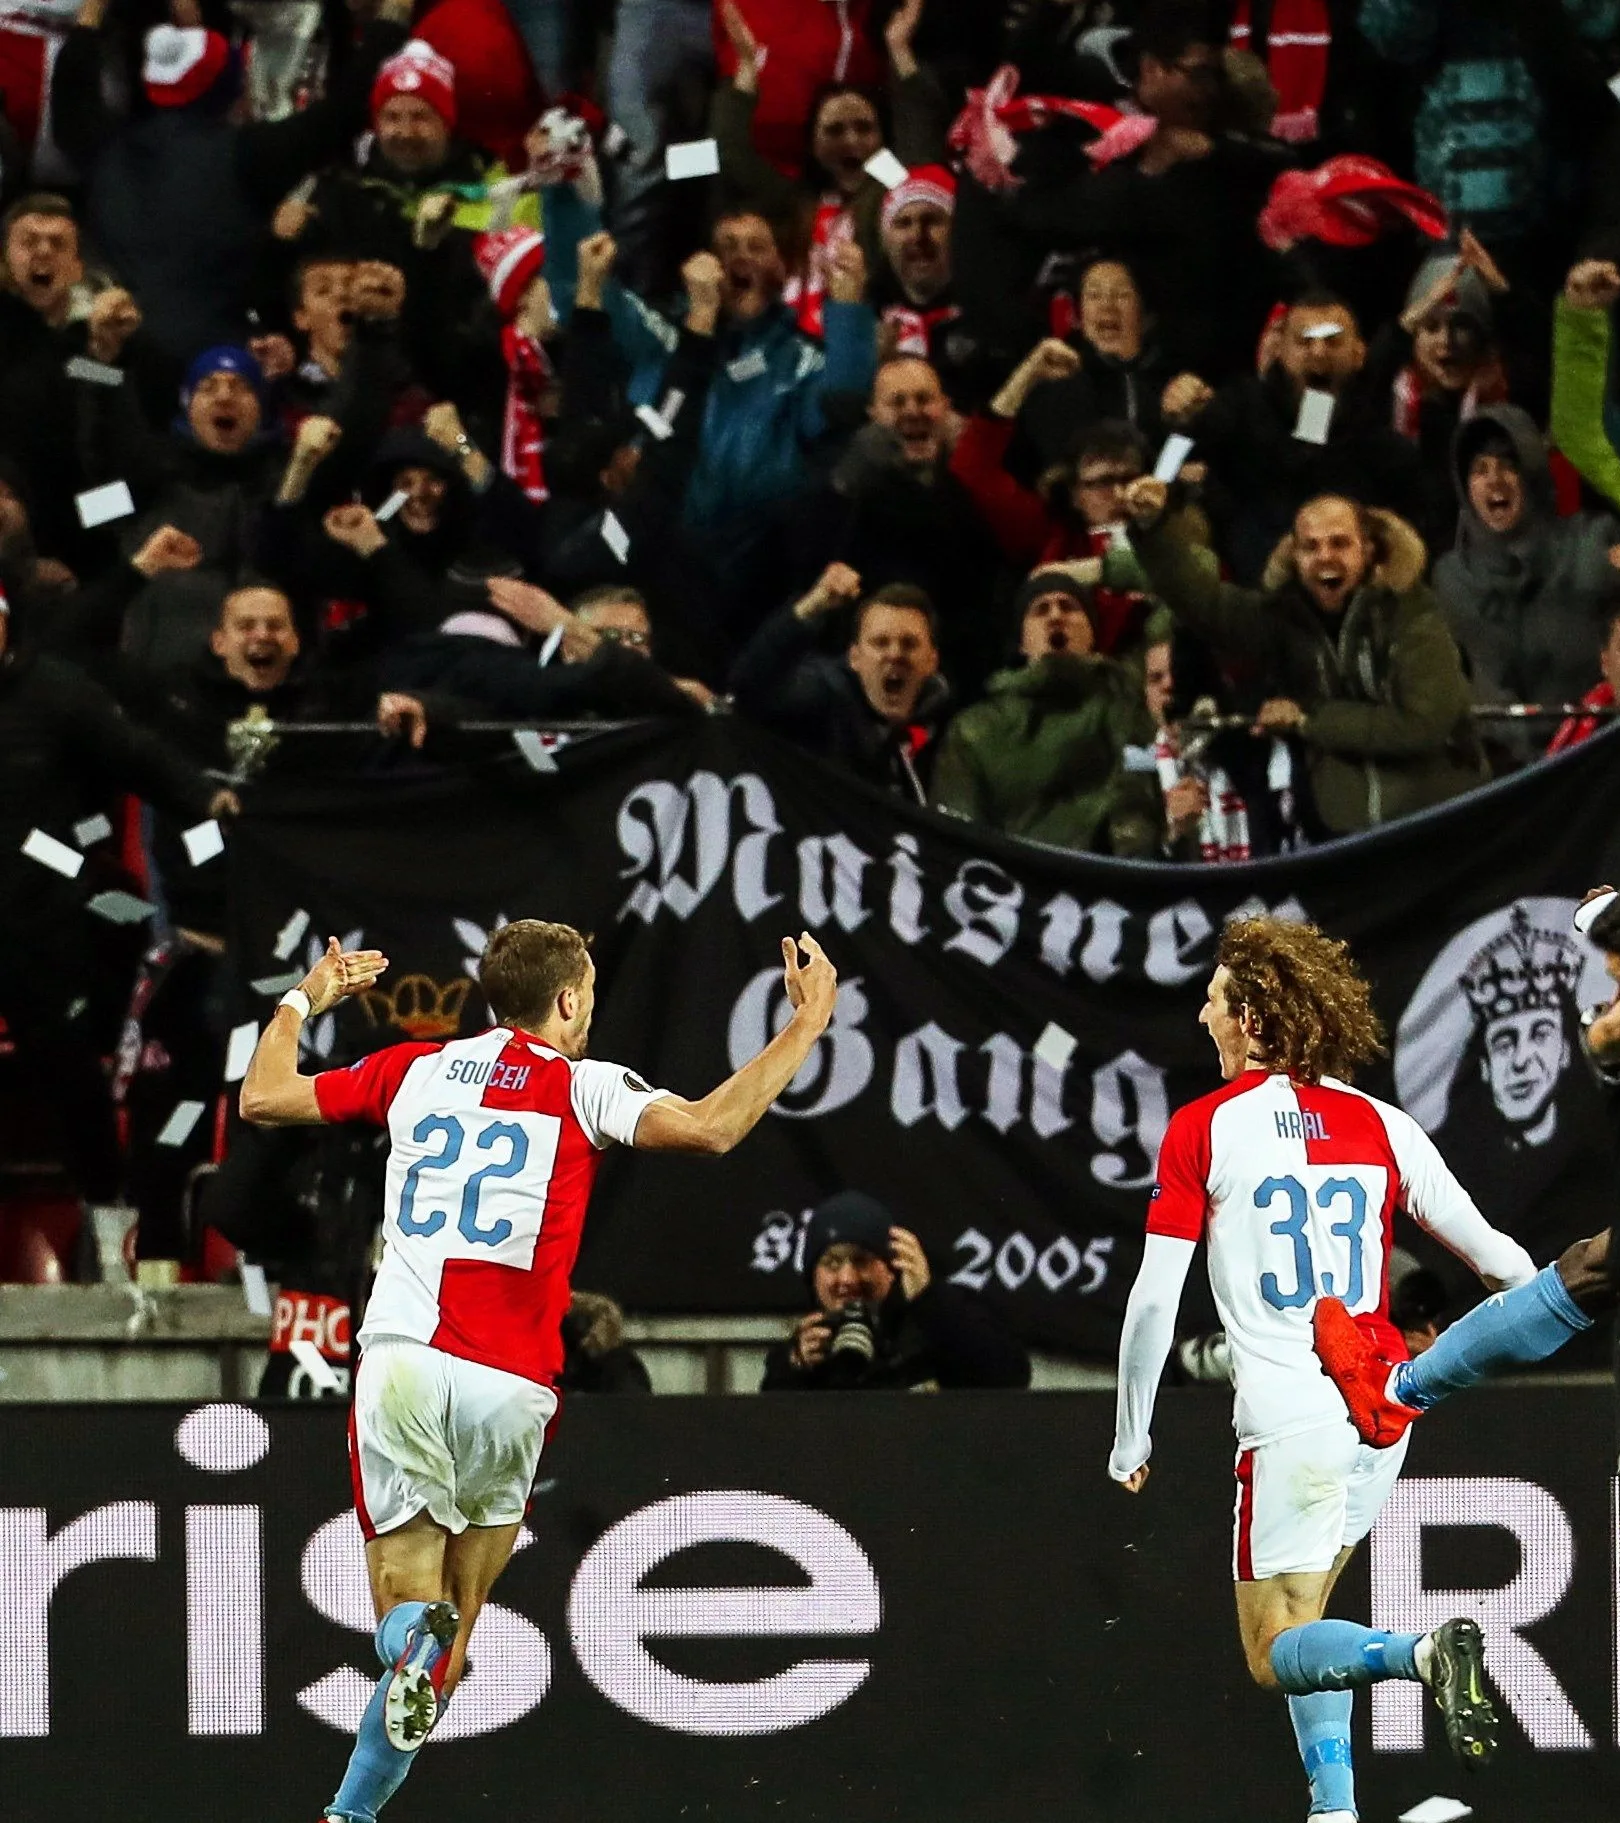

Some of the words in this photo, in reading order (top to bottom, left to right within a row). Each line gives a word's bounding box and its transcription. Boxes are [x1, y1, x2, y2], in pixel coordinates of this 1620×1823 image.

[617, 771, 1307, 986] Maisne
[446, 1058, 532, 1091] SOUČEK
[727, 967, 1168, 1188] Gang
[1274, 1107, 1331, 1141] KRÁL
[397, 1113, 530, 1247] 22
[1253, 1175, 1368, 1310] 33
[948, 1227, 1115, 1294] 2005
[0, 1402, 884, 1742] rise
